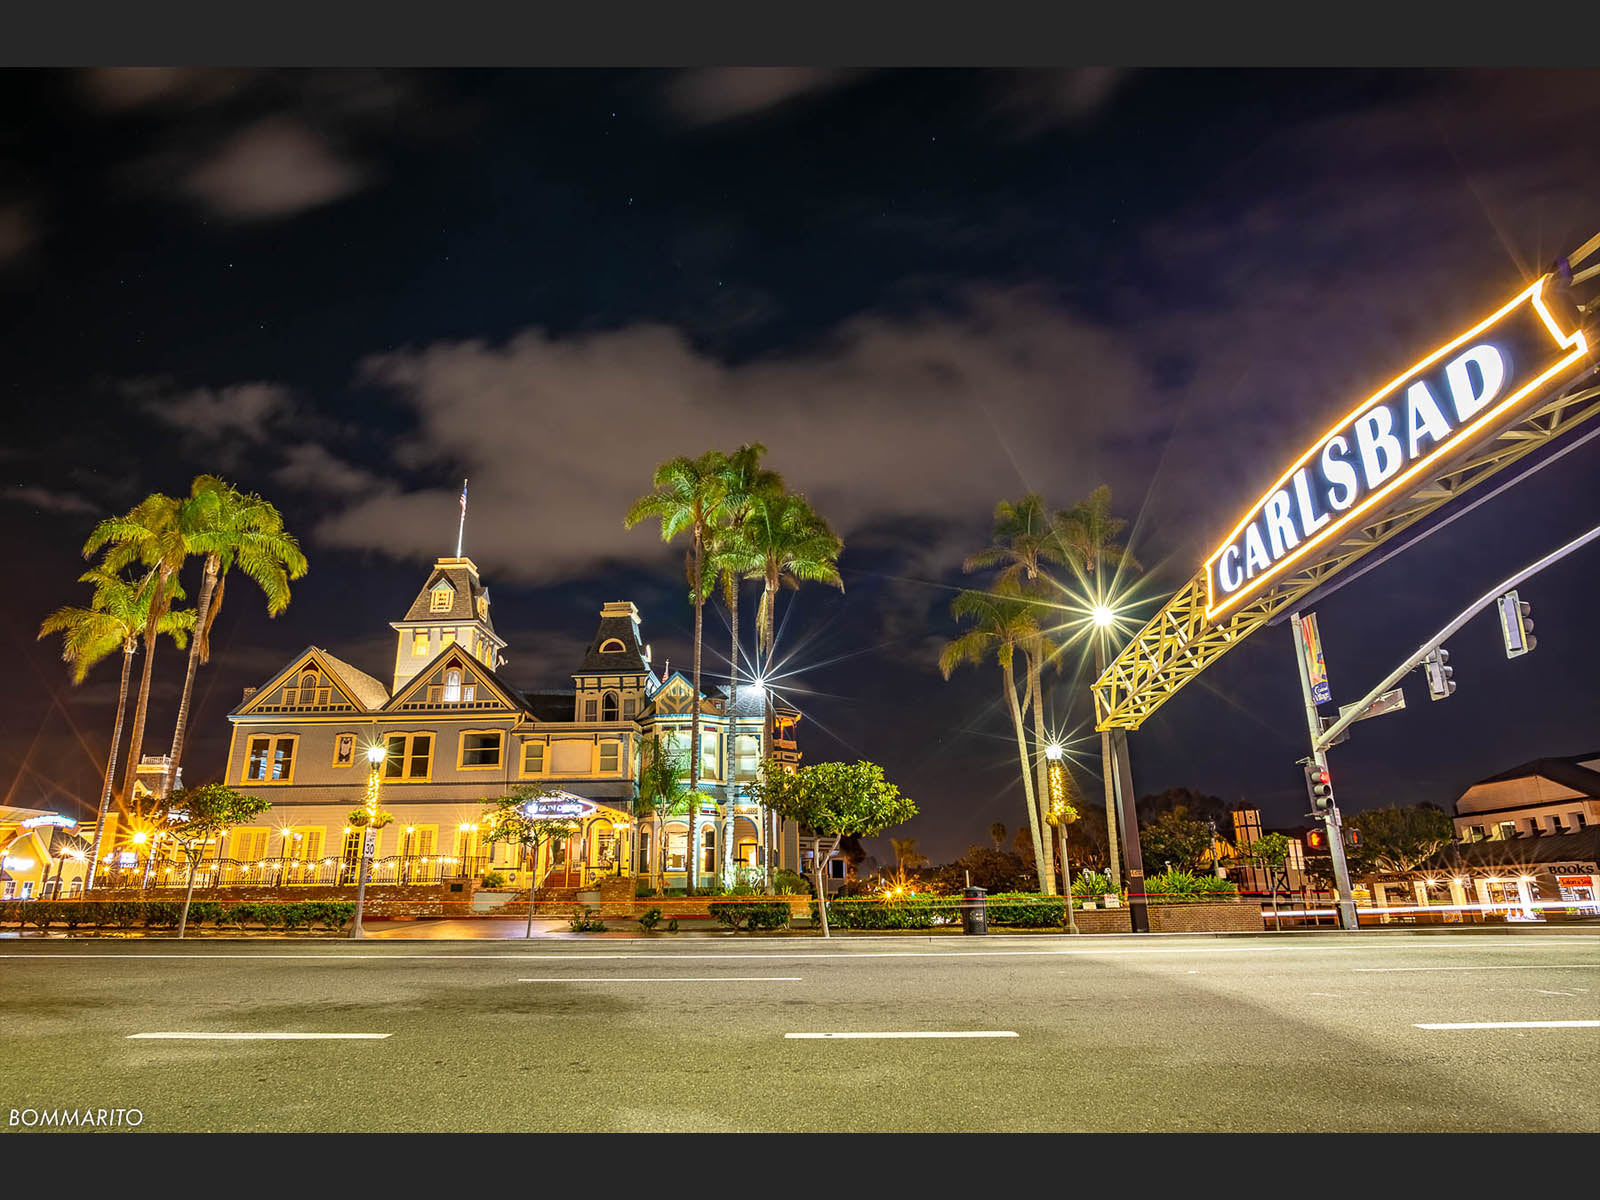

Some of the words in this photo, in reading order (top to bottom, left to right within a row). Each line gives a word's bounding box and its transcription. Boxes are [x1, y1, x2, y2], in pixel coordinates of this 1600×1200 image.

[1219, 344, 1504, 593] CARLSBAD
[365, 843, 375, 855] 30
[1548, 863, 1594, 875] BOOKS
